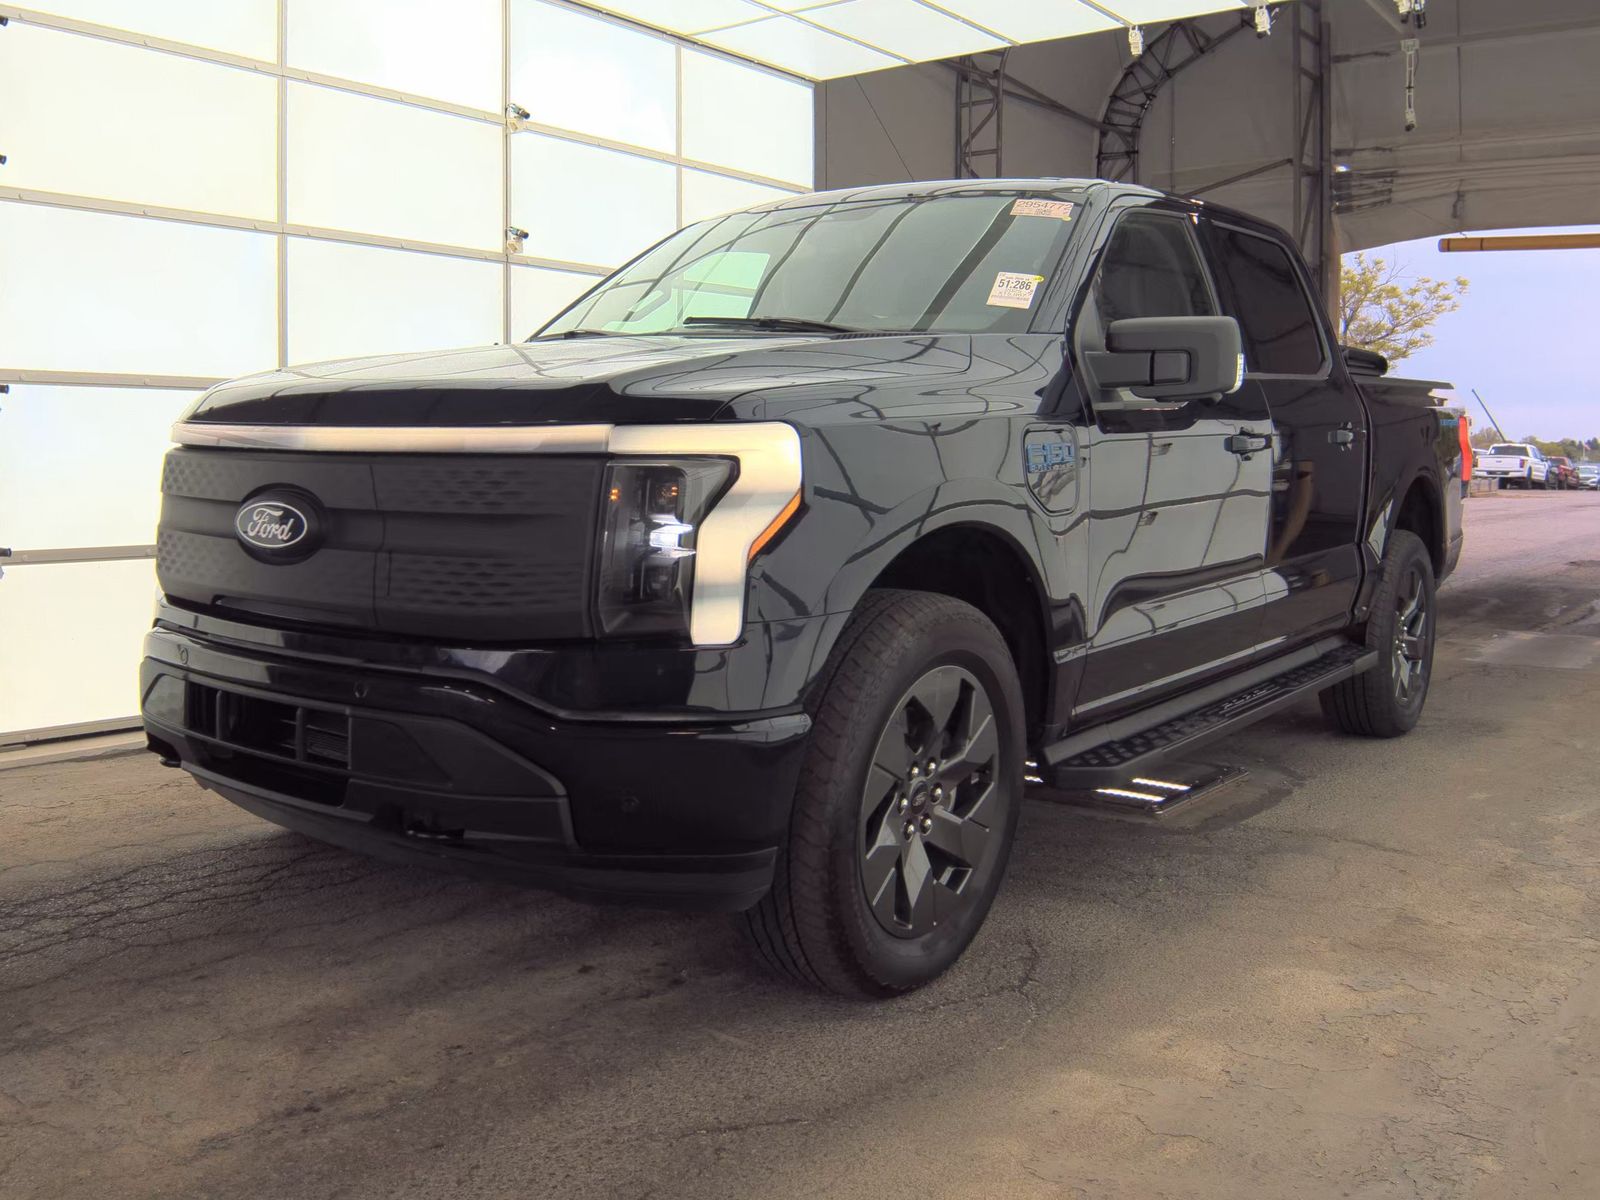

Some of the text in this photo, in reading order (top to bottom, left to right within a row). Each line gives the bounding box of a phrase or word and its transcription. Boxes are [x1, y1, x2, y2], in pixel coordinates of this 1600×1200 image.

[1016, 200, 1072, 210] 2954772
[998, 278, 1032, 291] 51:286
[247, 507, 295, 540] Ford
